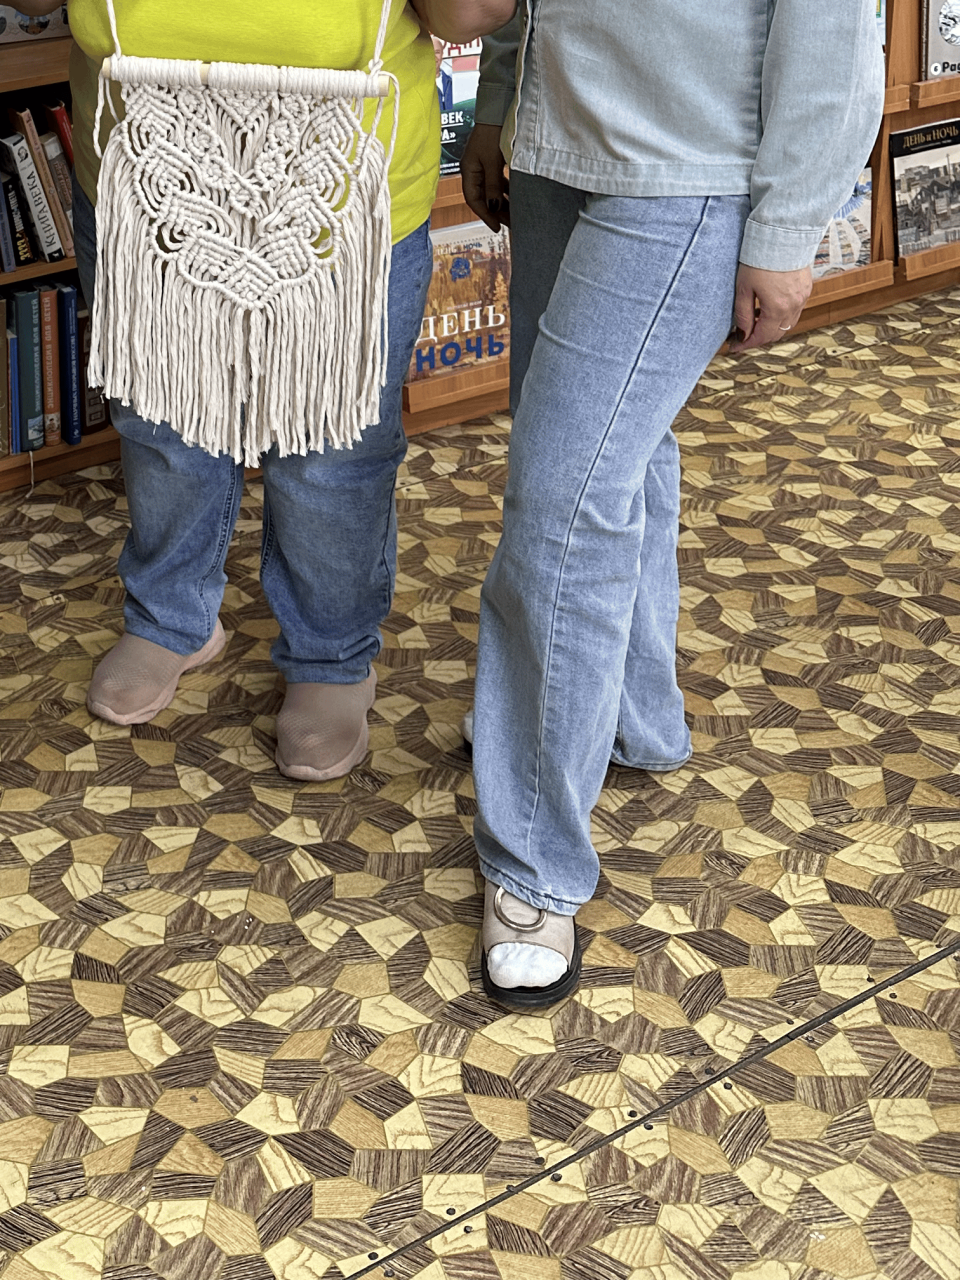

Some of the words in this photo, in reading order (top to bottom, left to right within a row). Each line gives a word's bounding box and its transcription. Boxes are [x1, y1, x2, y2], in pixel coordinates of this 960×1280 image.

[903, 133, 925, 149] ДЕНЬ
[933, 125, 959, 139] НОЧЬ
[27, 171, 43, 207] ВЕКА
[36, 208, 56, 247] КНИГА
[415, 305, 505, 346] ДЕНЬ
[416, 334, 504, 372] НОЧЬ
